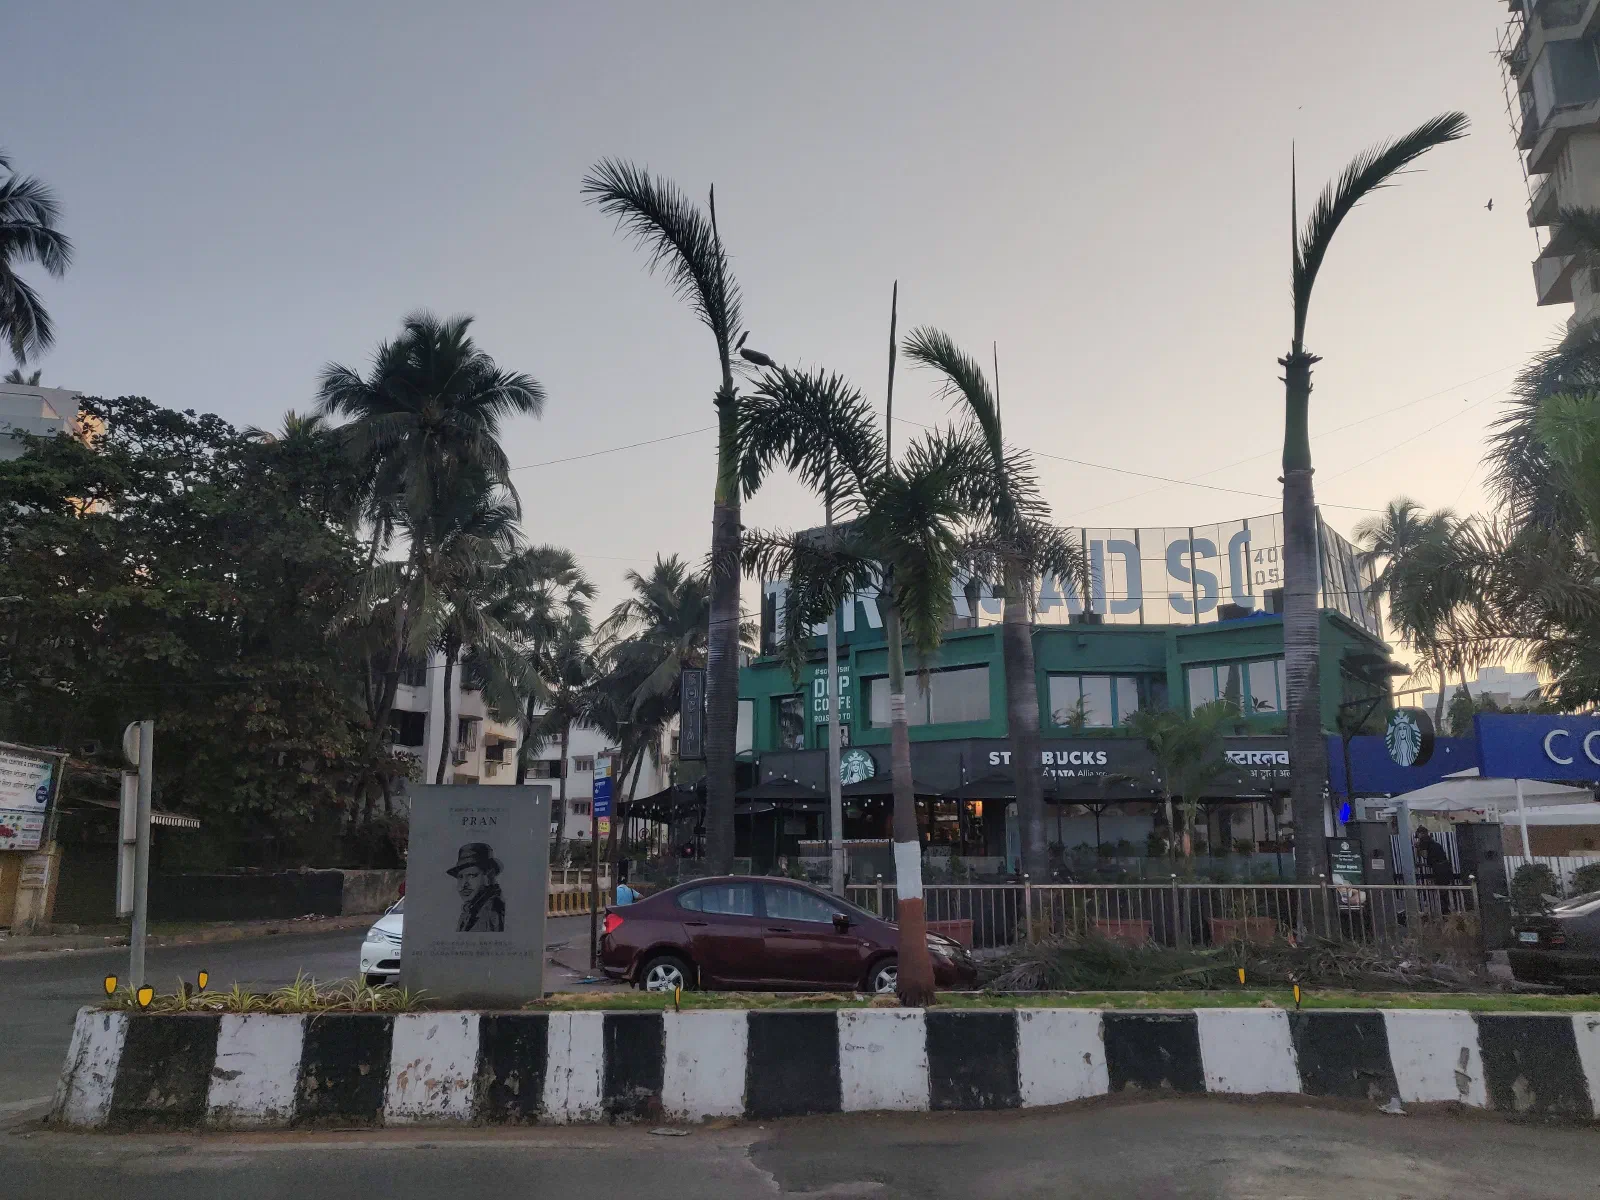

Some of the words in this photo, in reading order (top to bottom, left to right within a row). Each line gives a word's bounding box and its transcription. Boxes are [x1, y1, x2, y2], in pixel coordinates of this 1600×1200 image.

[1254, 547, 1285, 564] 40
[814, 675, 850, 698] DP
[814, 696, 851, 711] COFE
[813, 713, 841, 723] ROASD
[989, 751, 1108, 765] STBUCKS
[1050, 769, 1075, 777] TATA
[462, 816, 498, 826] PRAN
